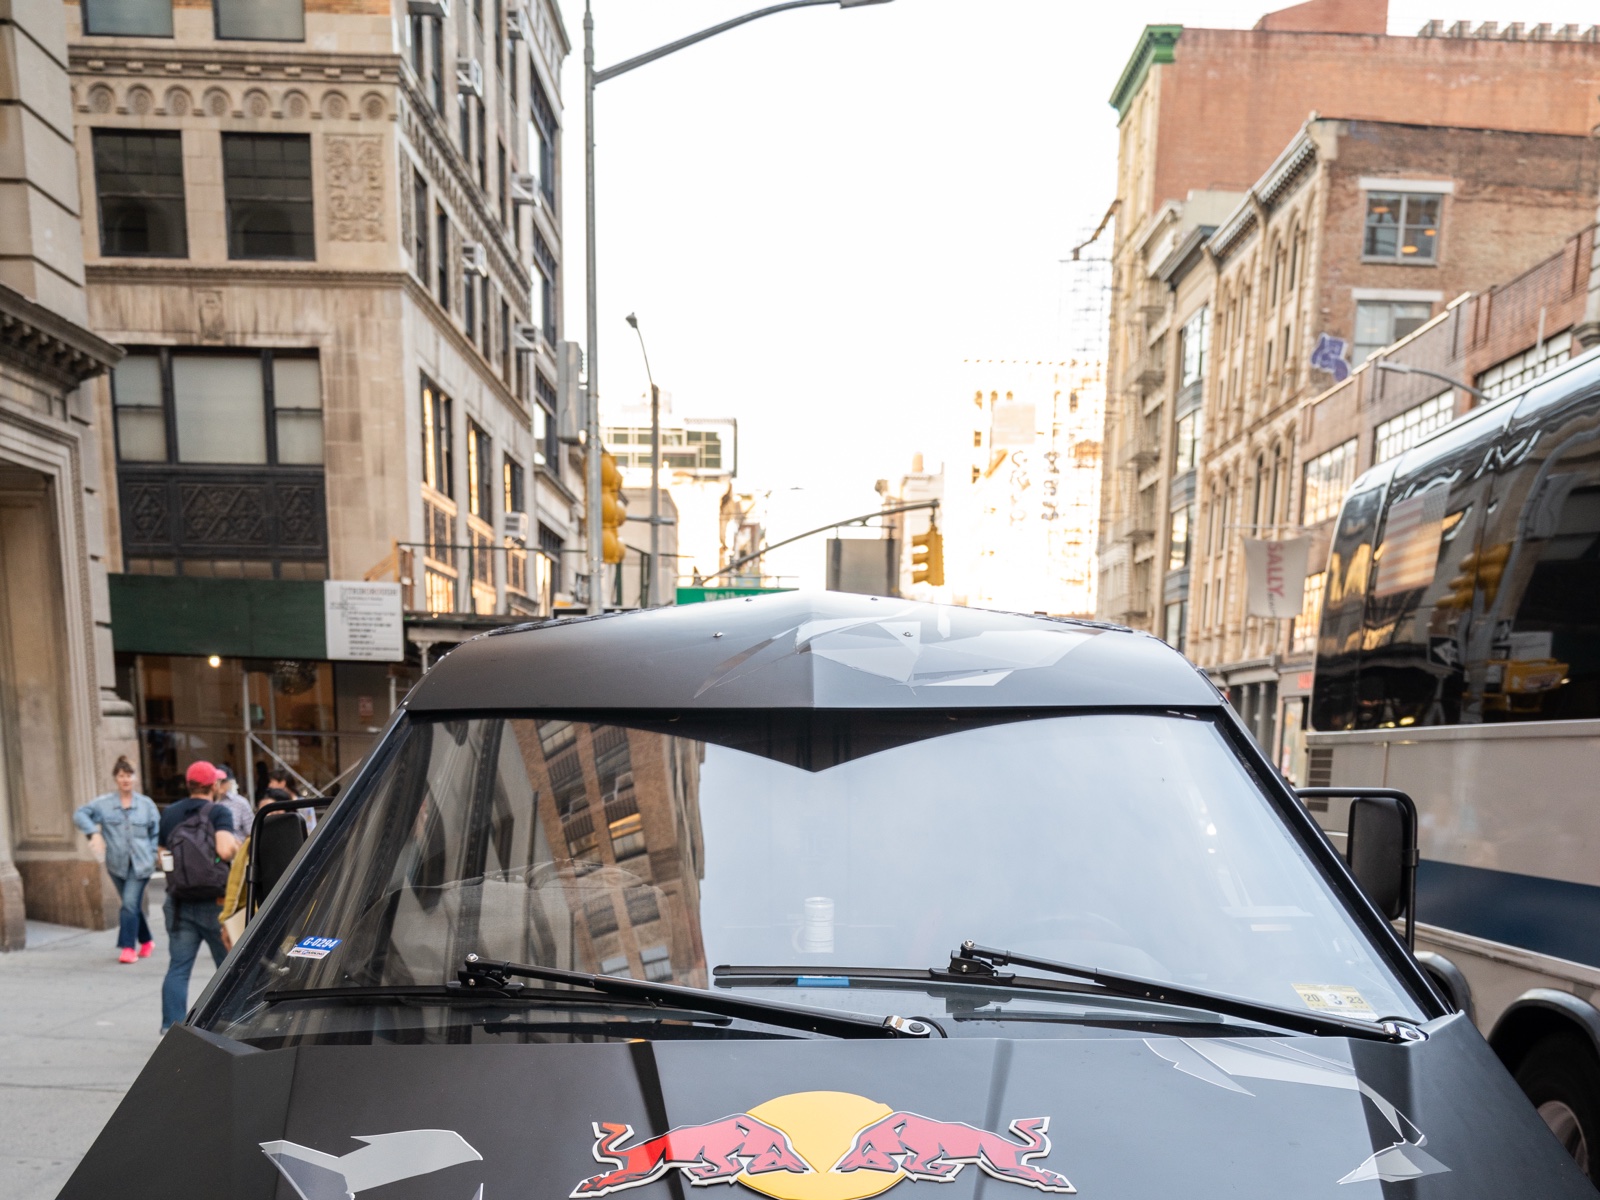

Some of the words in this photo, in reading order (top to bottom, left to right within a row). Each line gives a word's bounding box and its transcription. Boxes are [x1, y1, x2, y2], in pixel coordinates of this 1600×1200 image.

[1266, 541, 1285, 599] SALLY
[303, 937, 338, 949] G-0294
[1304, 993, 1321, 1002] 20
[1346, 995, 1364, 1005] 23
